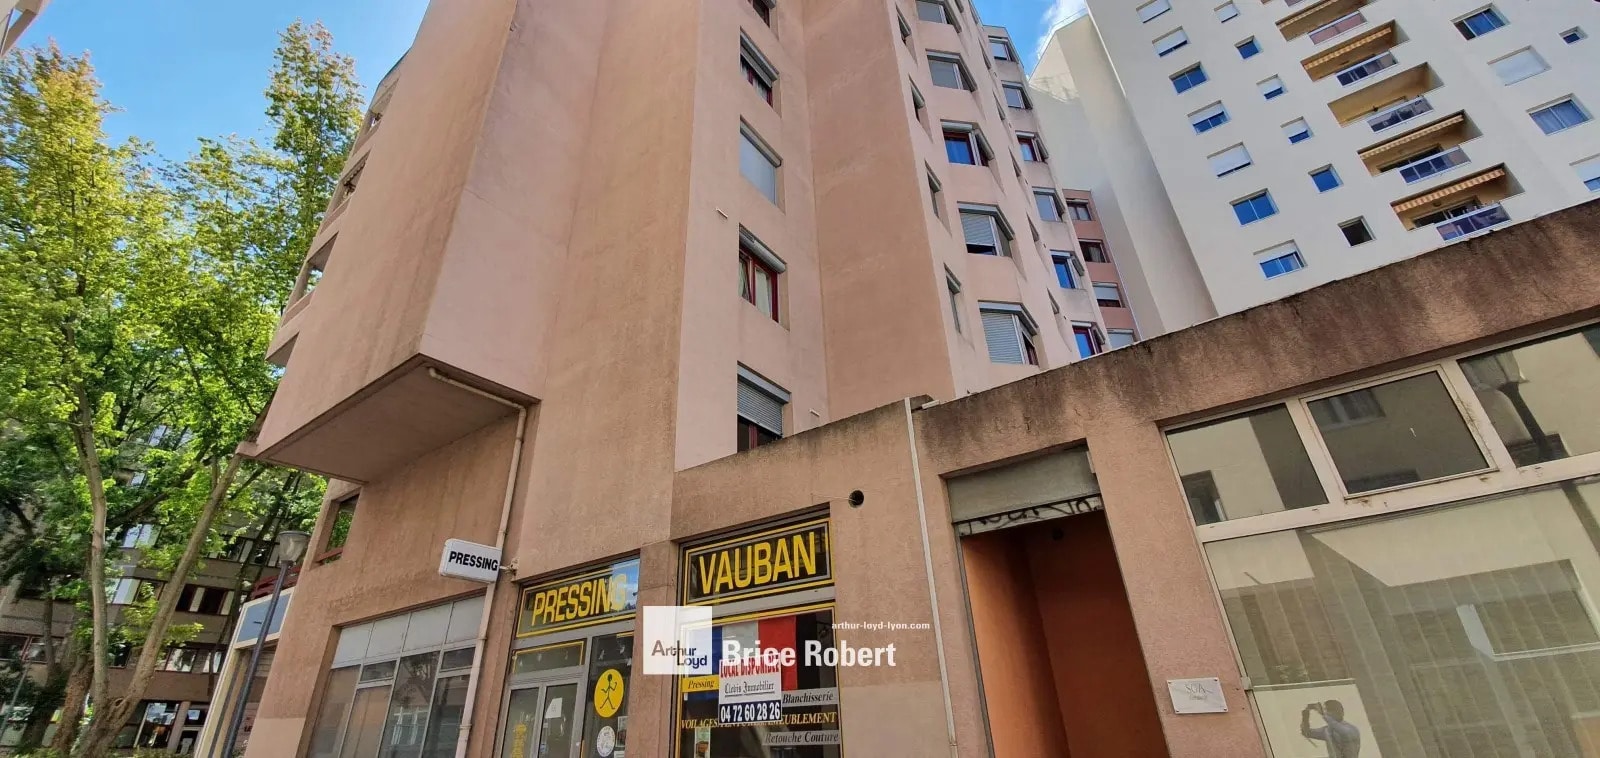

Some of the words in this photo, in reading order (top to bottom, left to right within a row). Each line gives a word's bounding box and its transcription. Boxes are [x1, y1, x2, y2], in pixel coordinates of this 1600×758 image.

[448, 550, 499, 571] PRESSING
[699, 531, 817, 595] VAUBAN
[531, 573, 628, 626] PRESSING
[687, 678, 715, 690] Pressing
[782, 690, 834, 704] Blanchisserie
[720, 705, 731, 723] 04
[732, 704, 743, 722] 72
[744, 703, 755, 722] 60
[756, 702, 768, 721] 28
[769, 701, 780, 720] 26
[765, 732, 802, 744] Retouche
[804, 730, 840, 743] Couture
